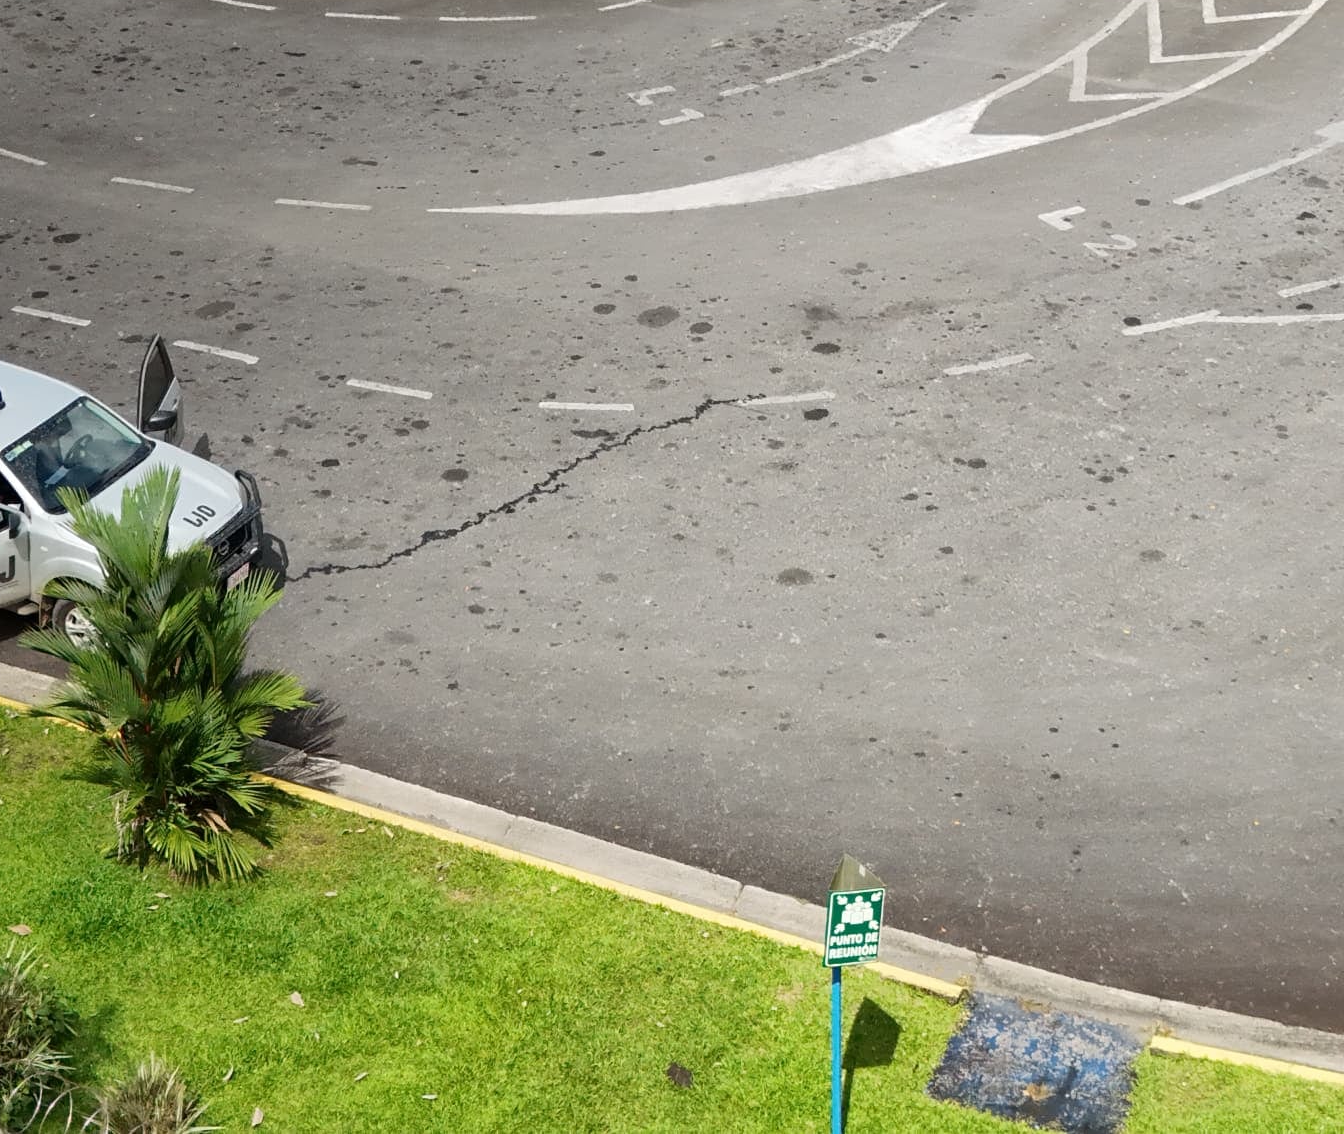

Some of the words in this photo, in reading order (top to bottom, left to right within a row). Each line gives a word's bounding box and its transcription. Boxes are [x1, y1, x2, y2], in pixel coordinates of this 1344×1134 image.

[183, 505, 216, 527] OIJ
[830, 933, 863, 947] PUNTO
[865, 931, 879, 943] DE
[828, 943, 877, 960] REUNIÓN
